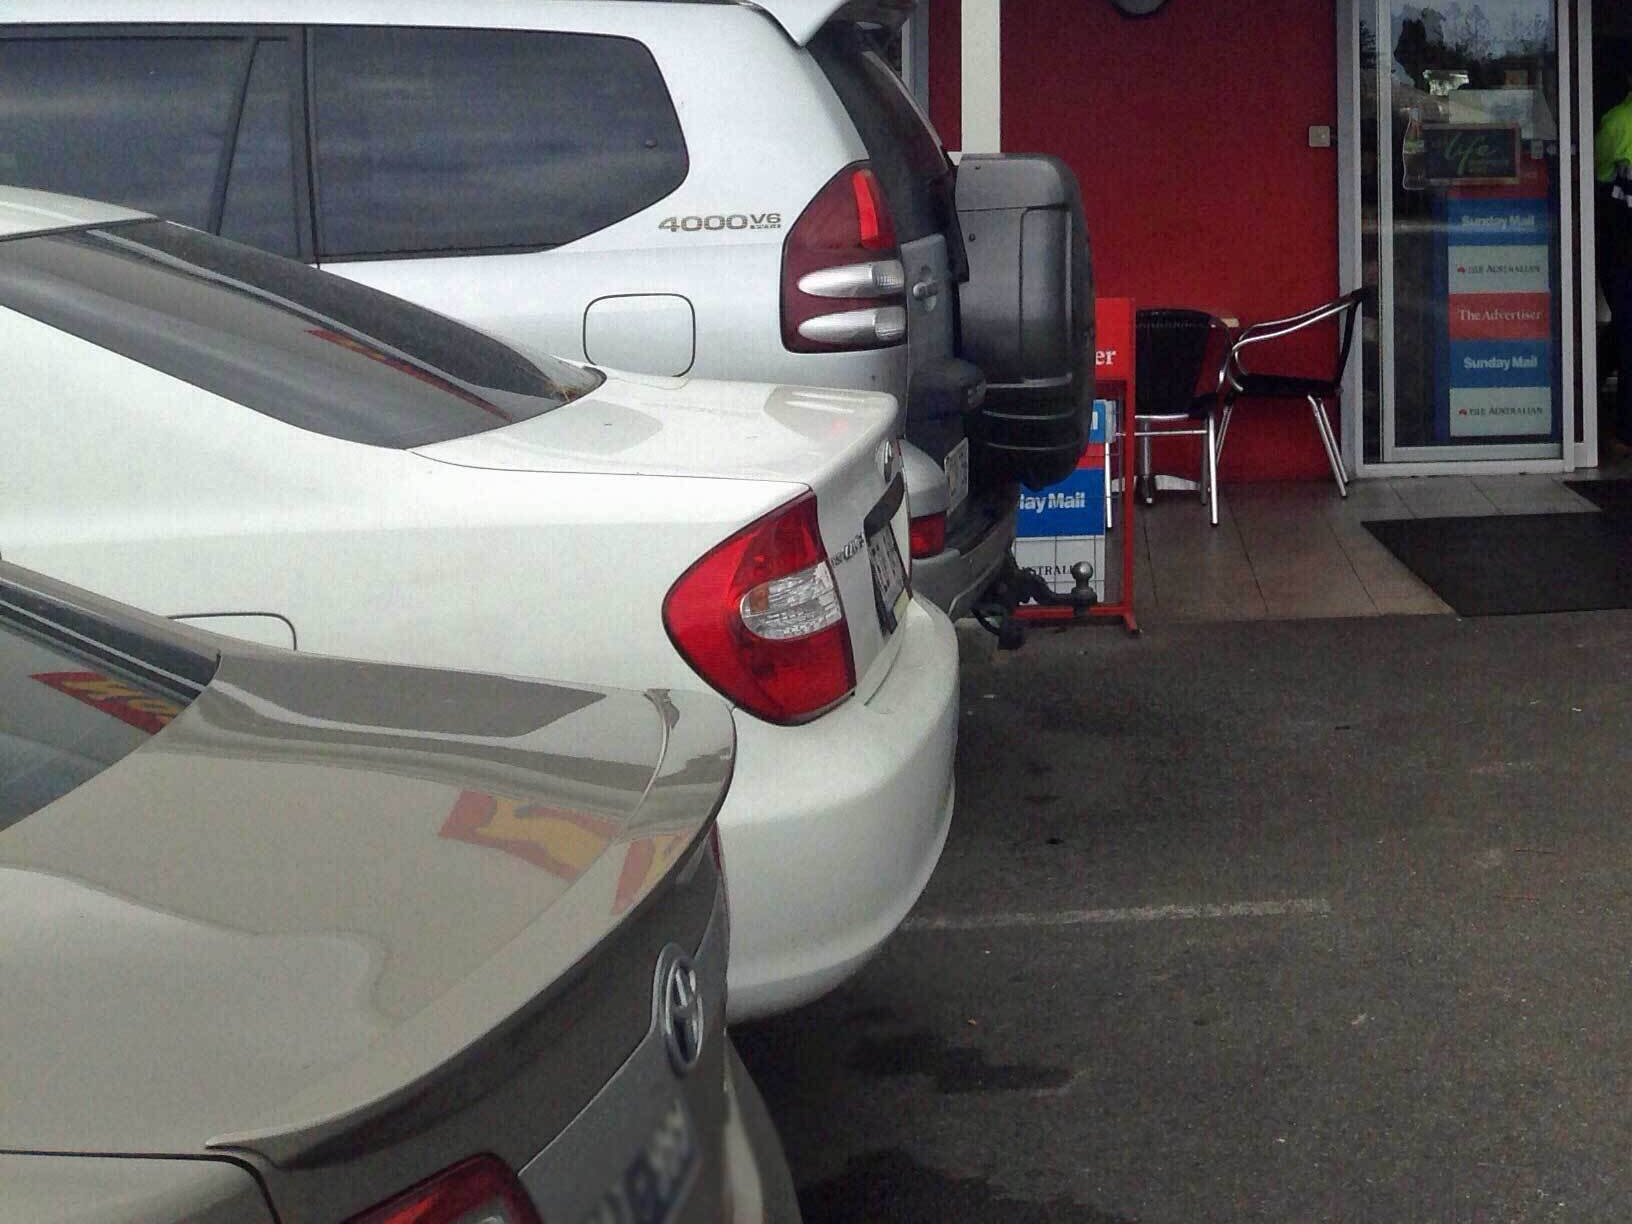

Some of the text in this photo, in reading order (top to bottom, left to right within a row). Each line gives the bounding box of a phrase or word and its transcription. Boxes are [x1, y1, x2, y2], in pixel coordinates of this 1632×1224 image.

[658, 212, 782, 233] 4000 V6
[1457, 309, 1481, 321] The
[1463, 355, 1538, 371] Sunday Mail
[1047, 491, 1086, 509] Mail
